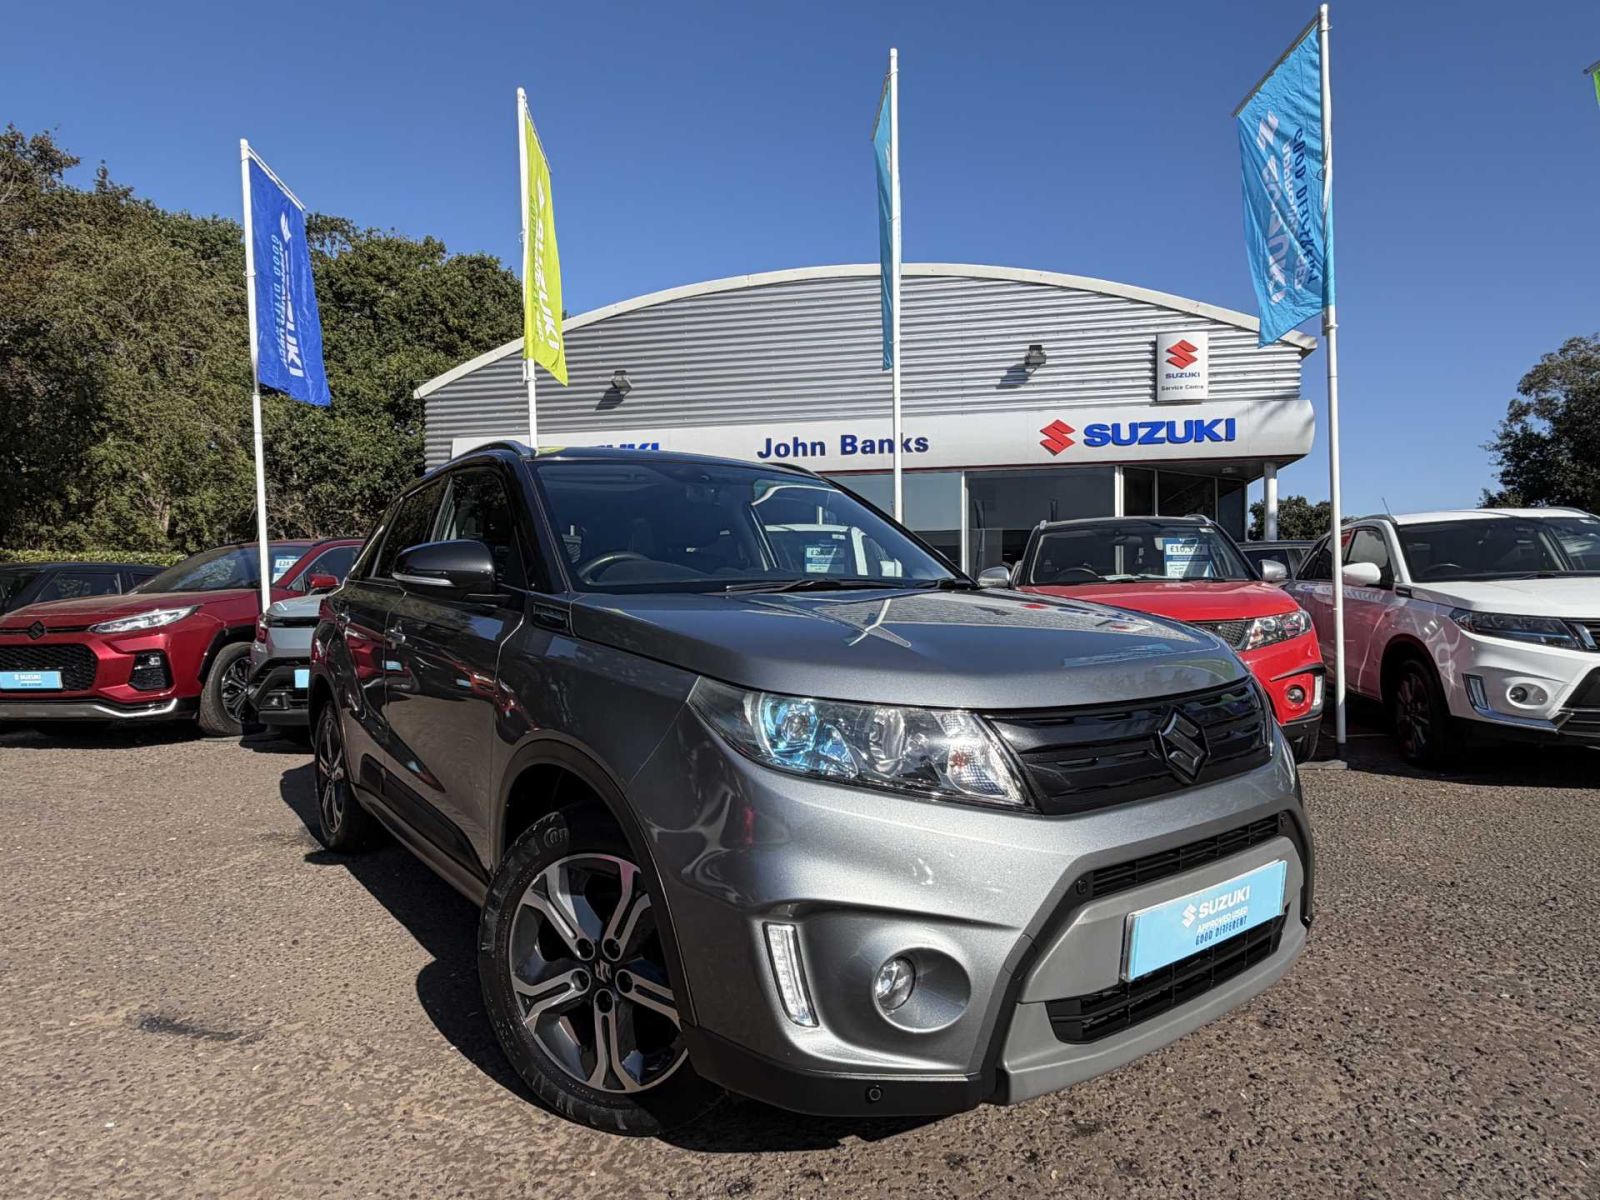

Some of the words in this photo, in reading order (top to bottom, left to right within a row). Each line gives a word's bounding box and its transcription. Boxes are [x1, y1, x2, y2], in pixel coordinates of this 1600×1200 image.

[1161, 384, 1183, 392] Service
[1165, 371, 1201, 380] SUZUKI
[756, 436, 826, 459] John
[839, 432, 929, 456] Banks
[1083, 417, 1236, 447] SUZUKI
[1198, 885, 1250, 919] SUZUKI
